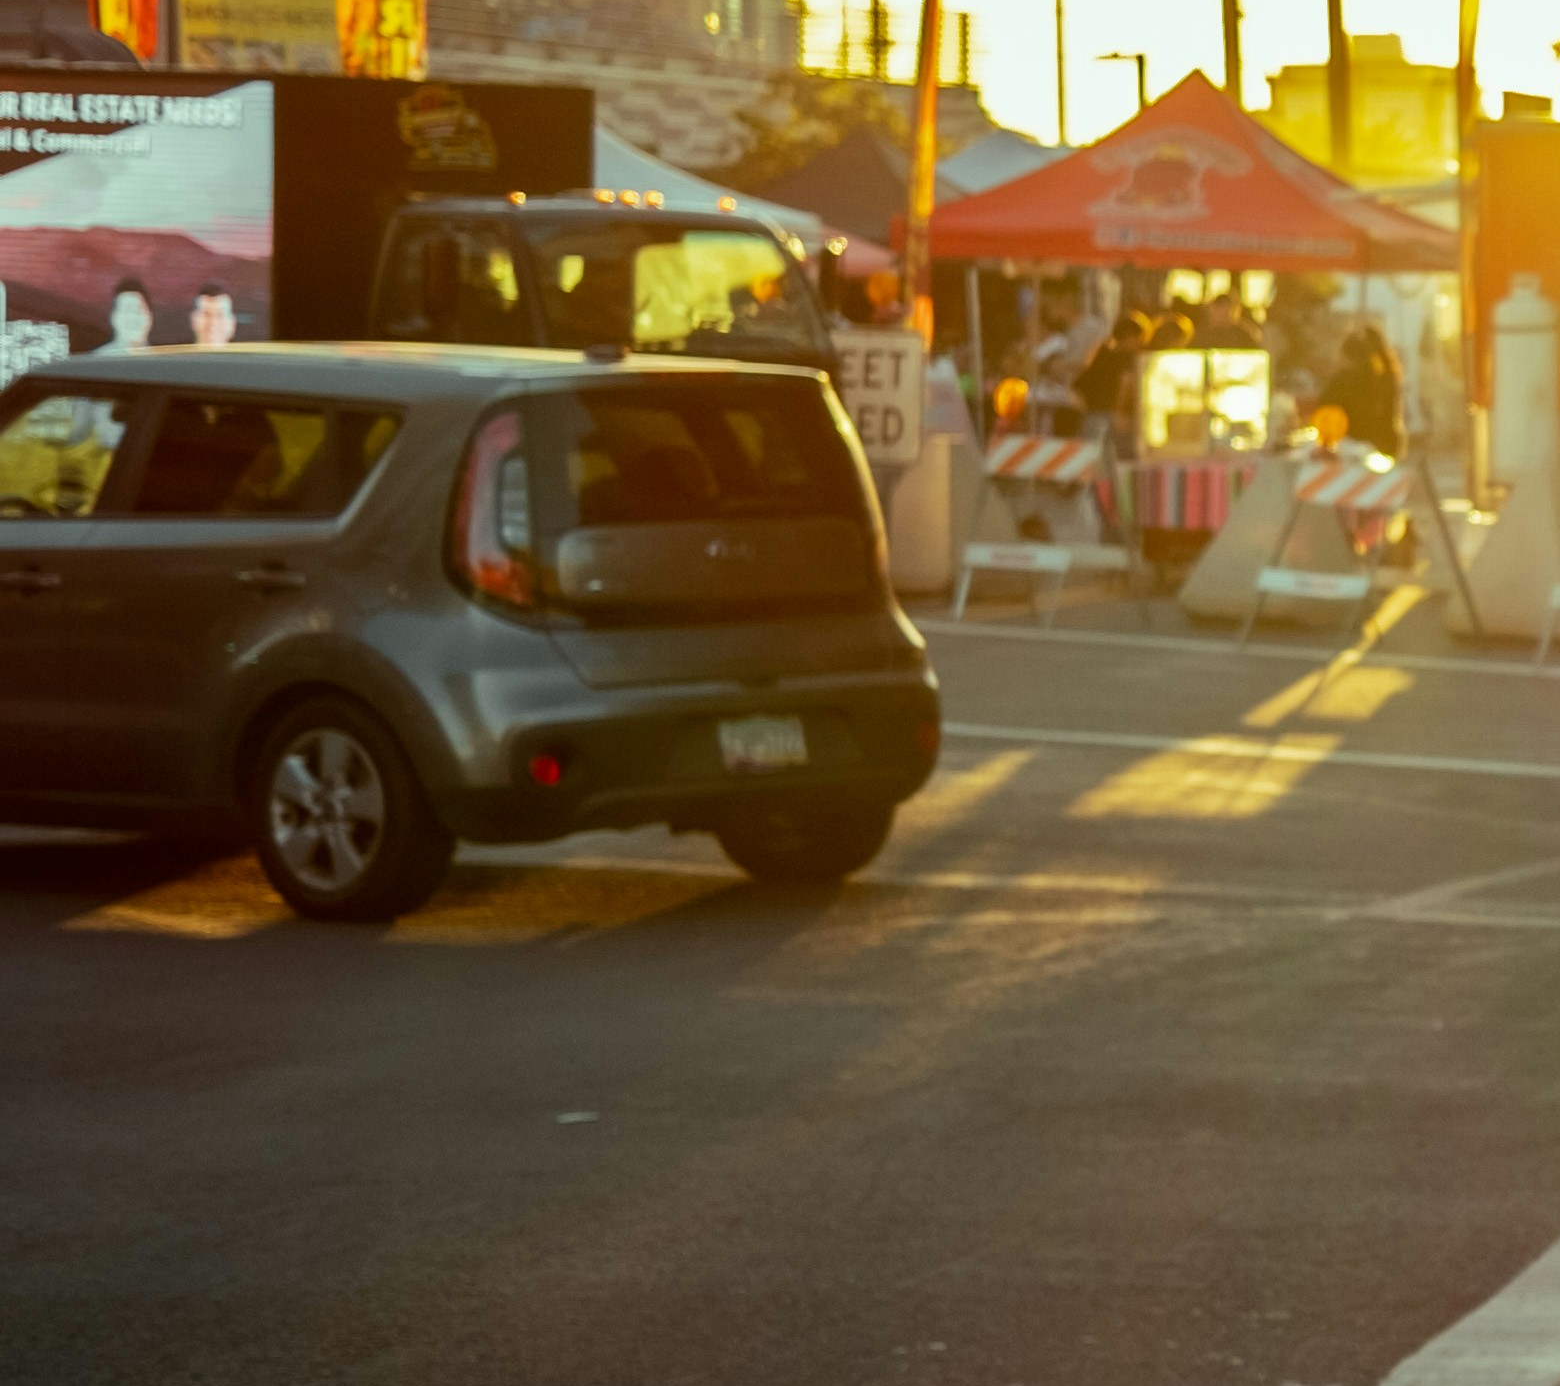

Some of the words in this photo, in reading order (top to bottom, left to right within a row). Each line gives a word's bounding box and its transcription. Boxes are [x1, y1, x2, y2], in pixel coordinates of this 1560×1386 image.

[21, 92, 77, 122] REAL
[79, 93, 163, 125] ESTATE
[839, 348, 906, 389] EET
